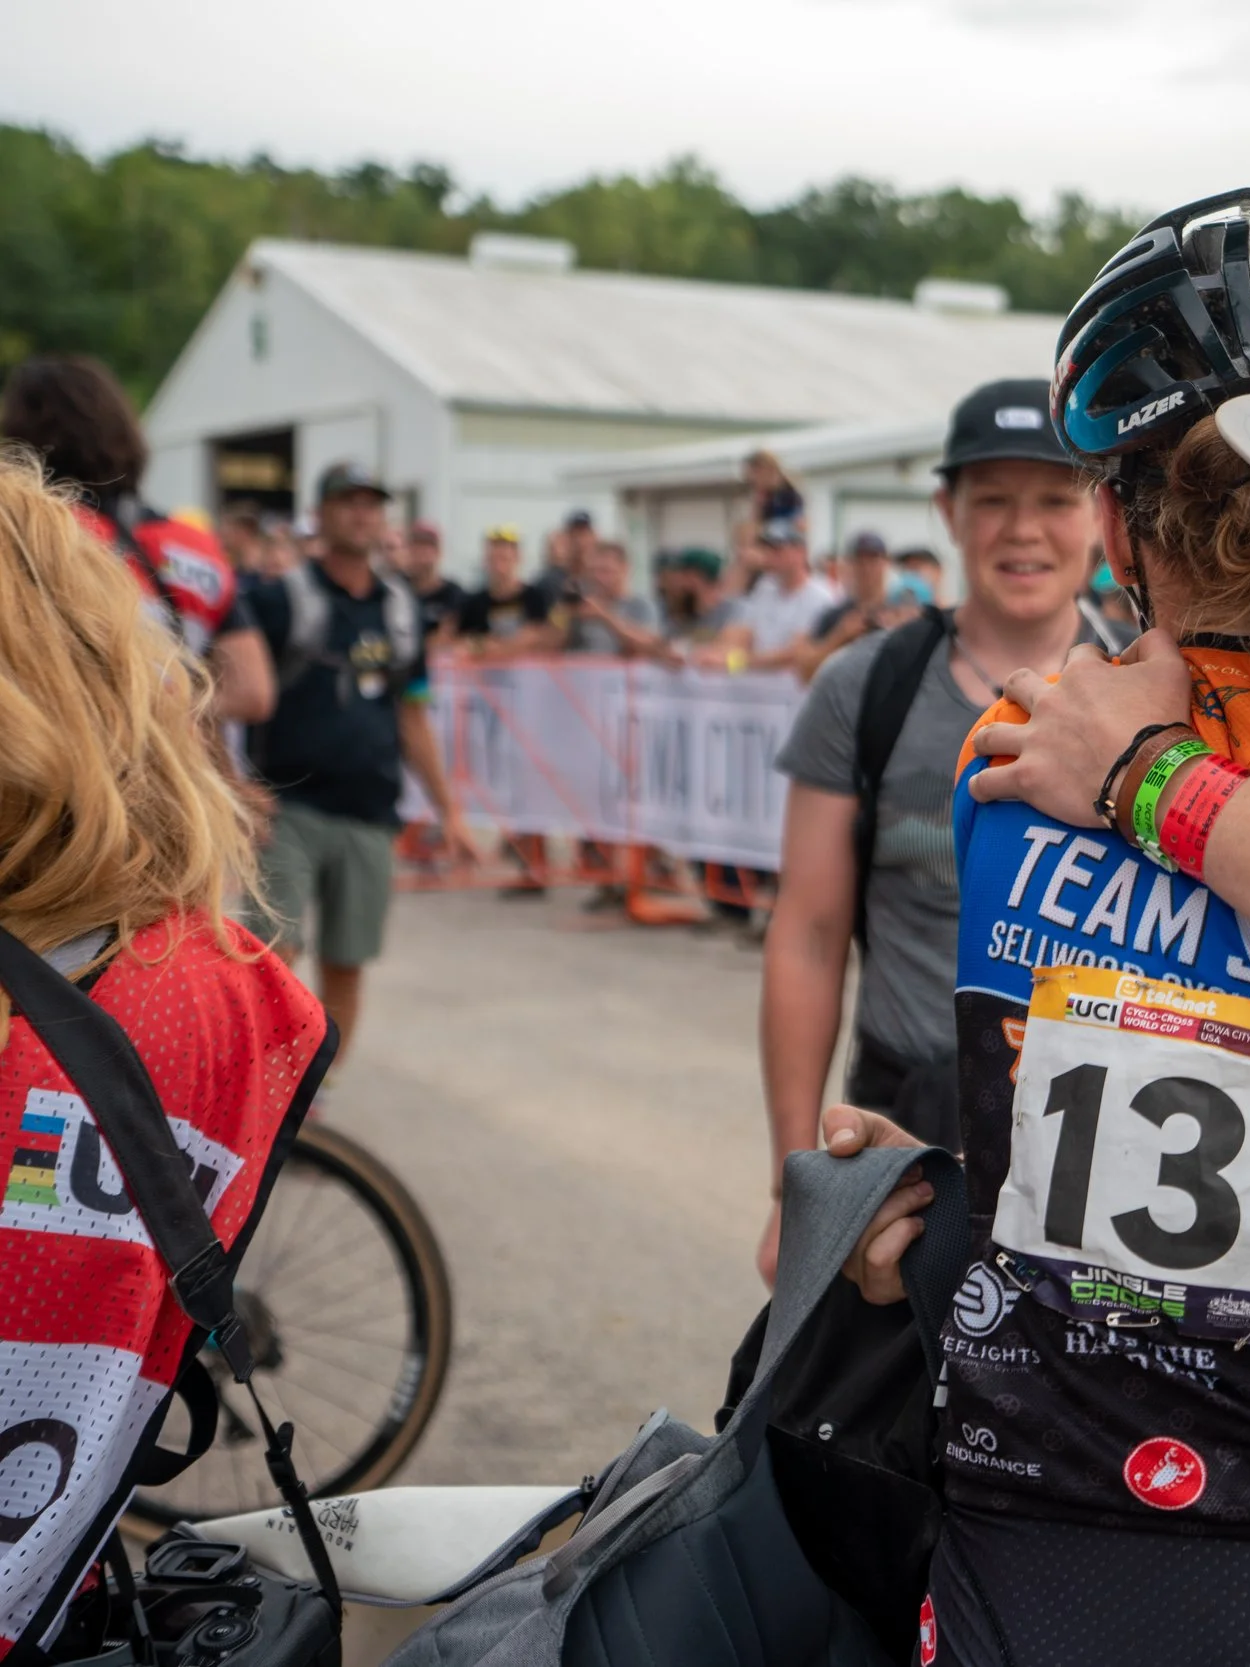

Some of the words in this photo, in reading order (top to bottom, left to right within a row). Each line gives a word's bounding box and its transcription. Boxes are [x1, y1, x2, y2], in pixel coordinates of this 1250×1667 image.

[1117, 390, 1186, 435] LAZER
[1006, 826, 1209, 967] TEAM
[1075, 999, 1118, 1022] UCI
[1125, 1006, 1194, 1027] CYCLO-CROSS
[1145, 988, 1217, 1016] telenet
[1123, 1016, 1159, 1031] WORLD
[1159, 1023, 1181, 1034] CUP
[1200, 1032, 1221, 1045] USA
[1202, 1022, 1231, 1037] IOWA
[1043, 1063, 1245, 1270] 13
[1071, 1267, 1187, 1301] JINGLE
[1071, 1281, 1185, 1317] CROSS
[939, 1333, 1041, 1364] EFLIGHTS
